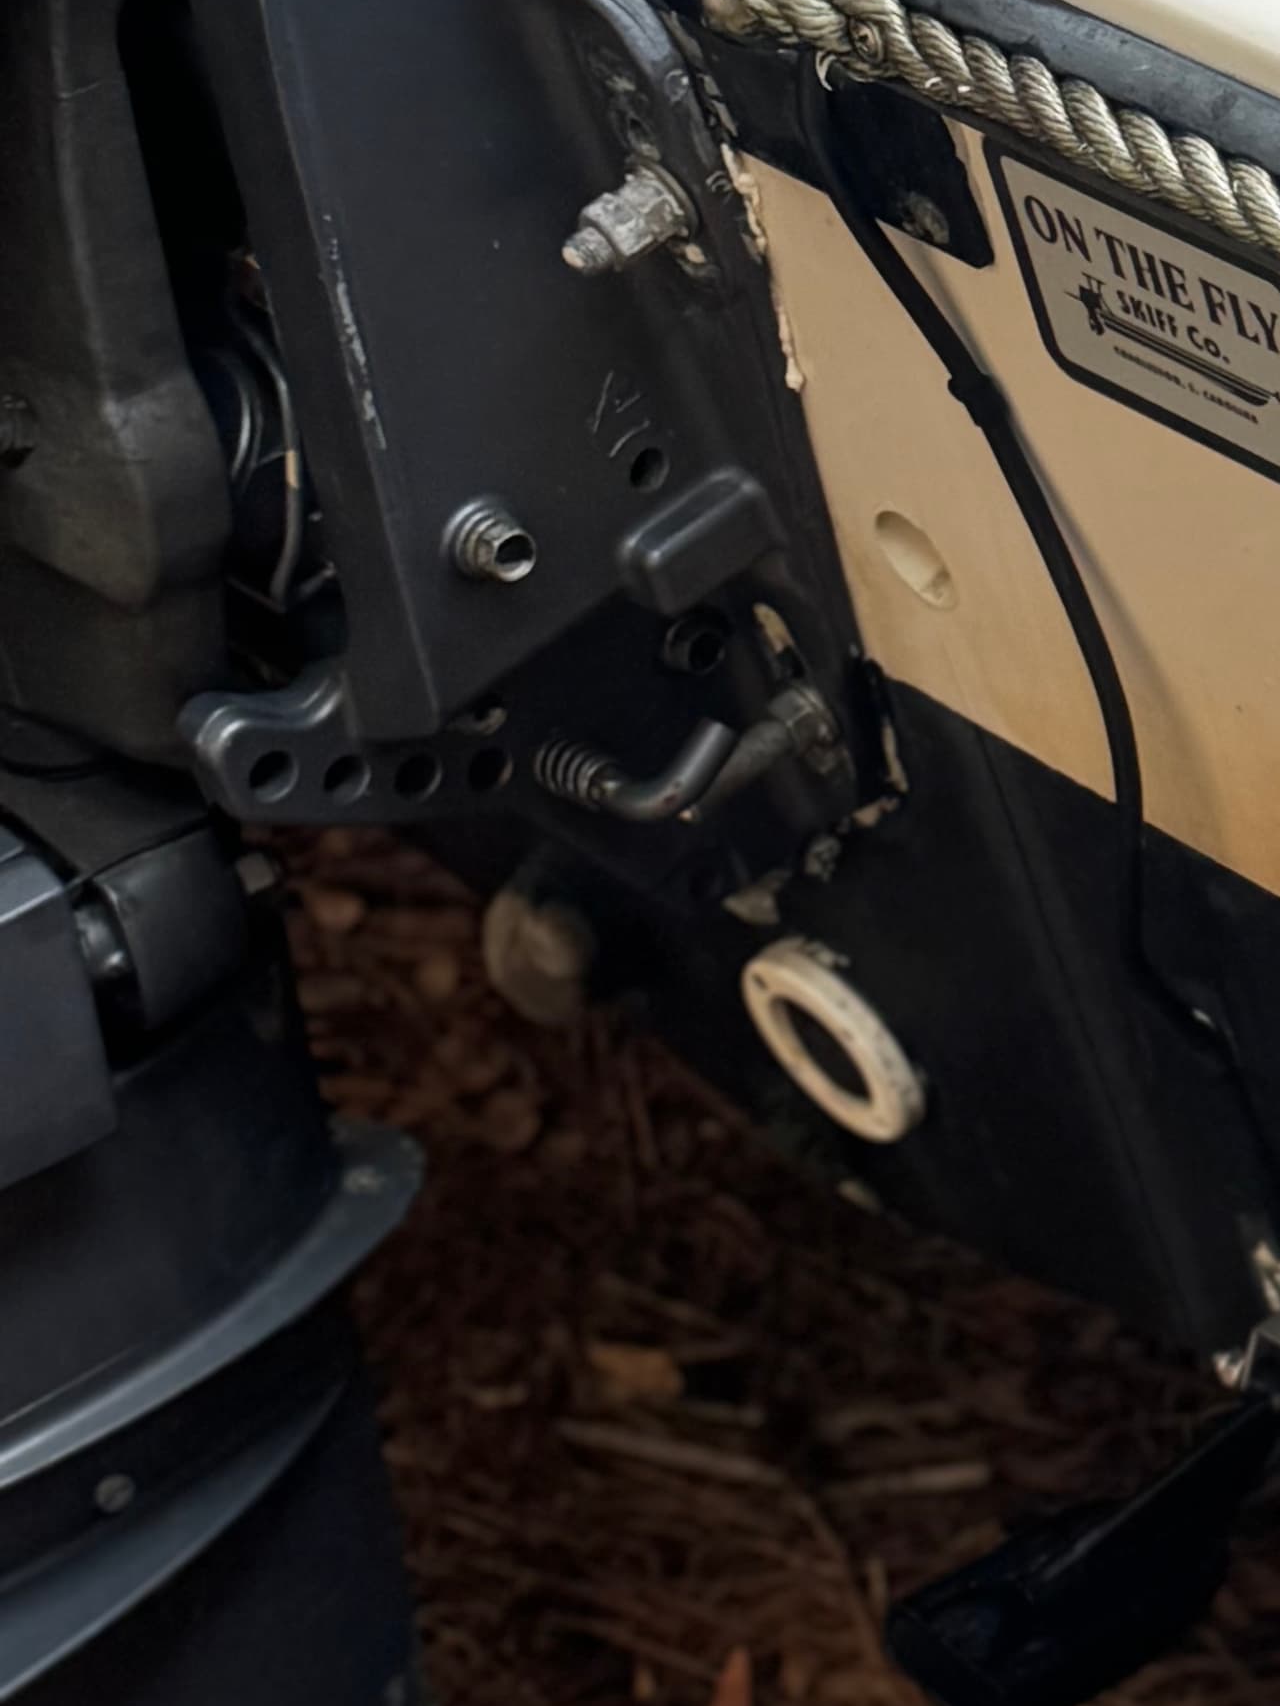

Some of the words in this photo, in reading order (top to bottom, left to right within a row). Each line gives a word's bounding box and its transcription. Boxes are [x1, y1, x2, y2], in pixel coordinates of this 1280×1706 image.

[1024, 195, 1092, 263] ON
[1094, 227, 1195, 313] THE
[1198, 277, 1280, 354] FLY
[1116, 289, 1178, 338] SKIFF
